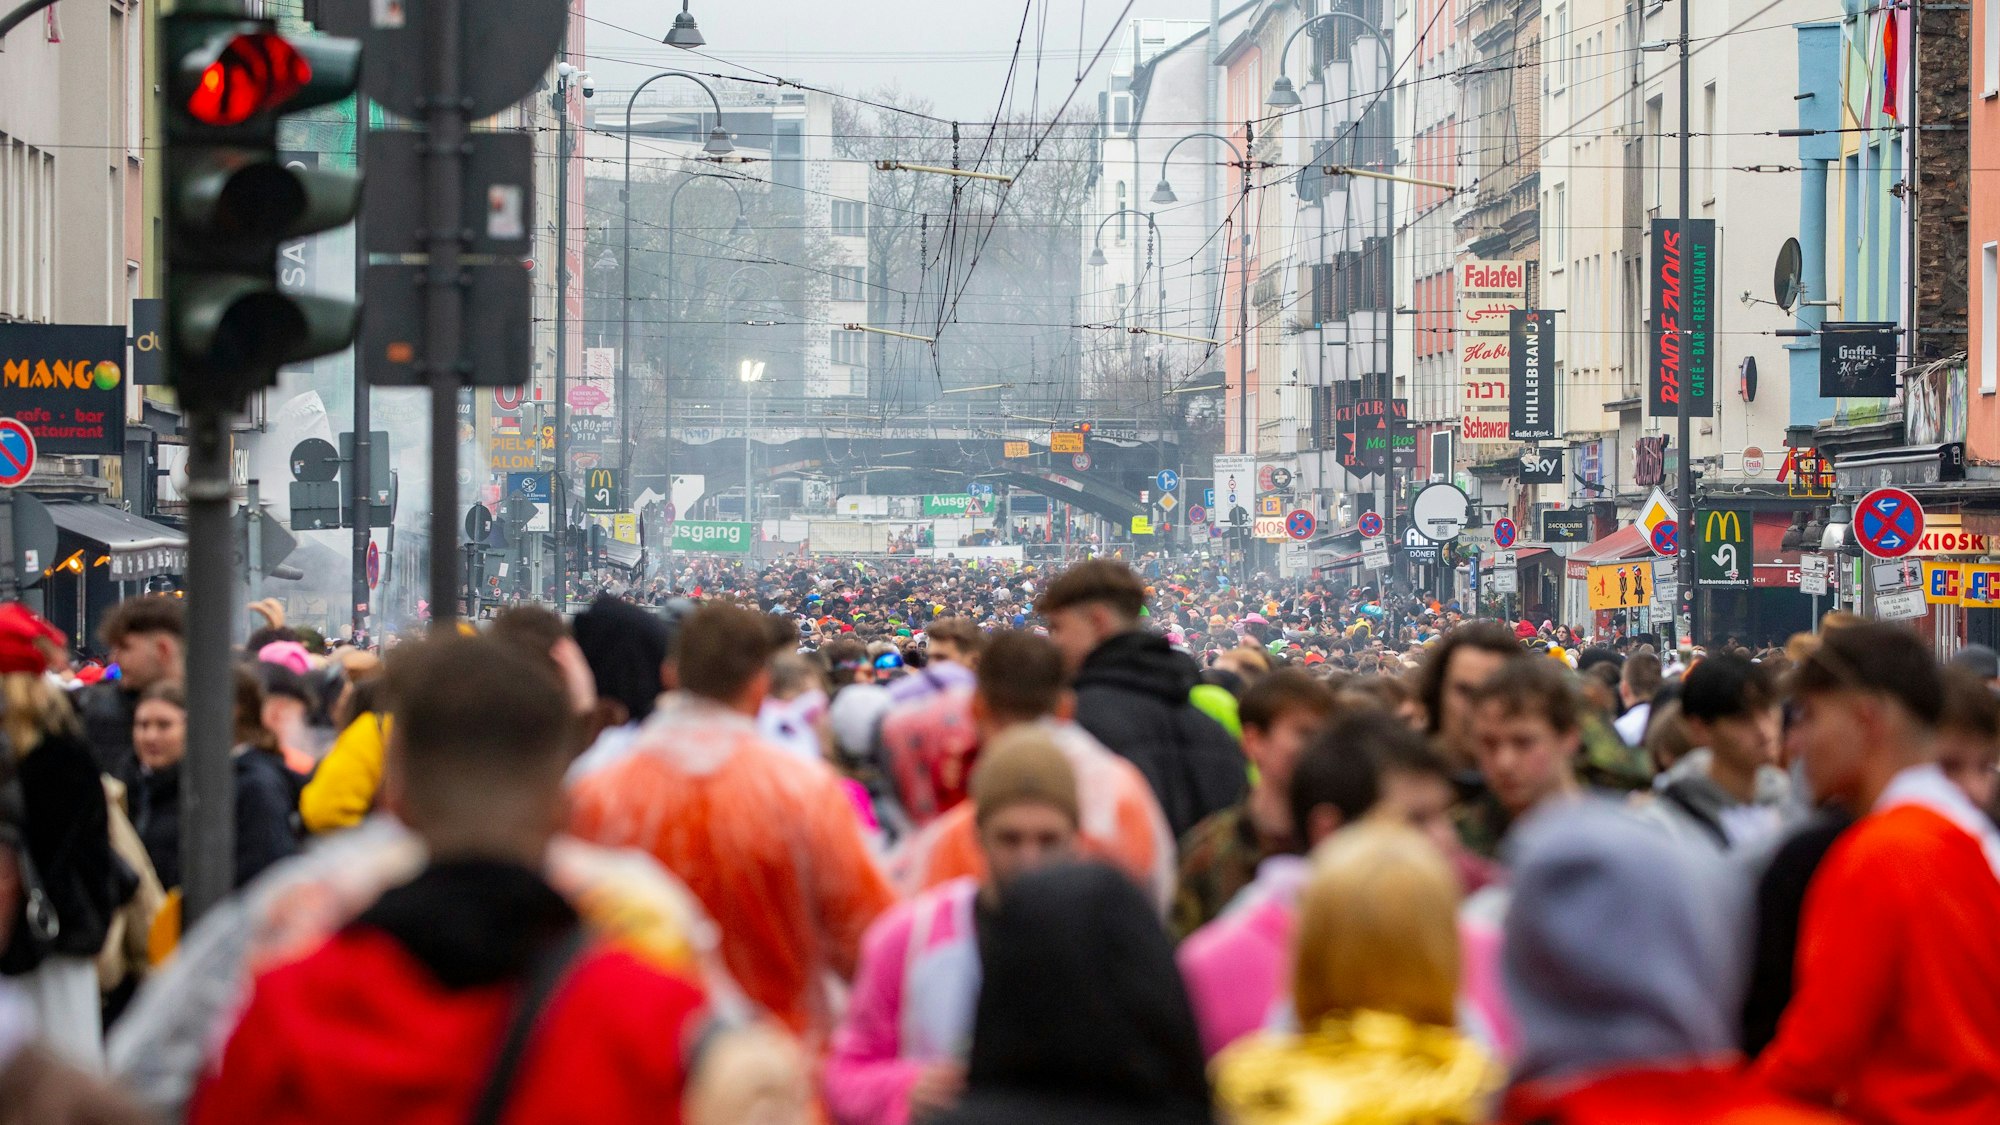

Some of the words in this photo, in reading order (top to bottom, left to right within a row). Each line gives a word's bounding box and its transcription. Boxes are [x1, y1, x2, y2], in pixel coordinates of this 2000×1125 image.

[1465, 264, 1522, 288] Falafel
[1693, 243, 1707, 321] RESTAURANT
[1693, 329, 1706, 355] BAR
[1464, 342, 1510, 362] Habi
[1838, 345, 1878, 360] Gaffel
[1690, 365, 1705, 397] CAFÉ
[16, 408, 51, 423] cafe
[75, 408, 105, 423] bar
[33, 426, 104, 438] staurant
[571, 419, 600, 433] GYROS
[1464, 415, 1509, 439] Schawar
[491, 438, 525, 451] PIEL
[577, 433, 597, 441] PITA
[1366, 435, 1415, 450] Moitos
[491, 456, 535, 468] ALON
[671, 525, 740, 543] usgang
[1254, 521, 1287, 535] KIOS
[1918, 533, 1985, 550] KIOSK
[1410, 549, 1436, 557] DÖNER
[1787, 570, 1800, 583] Es
